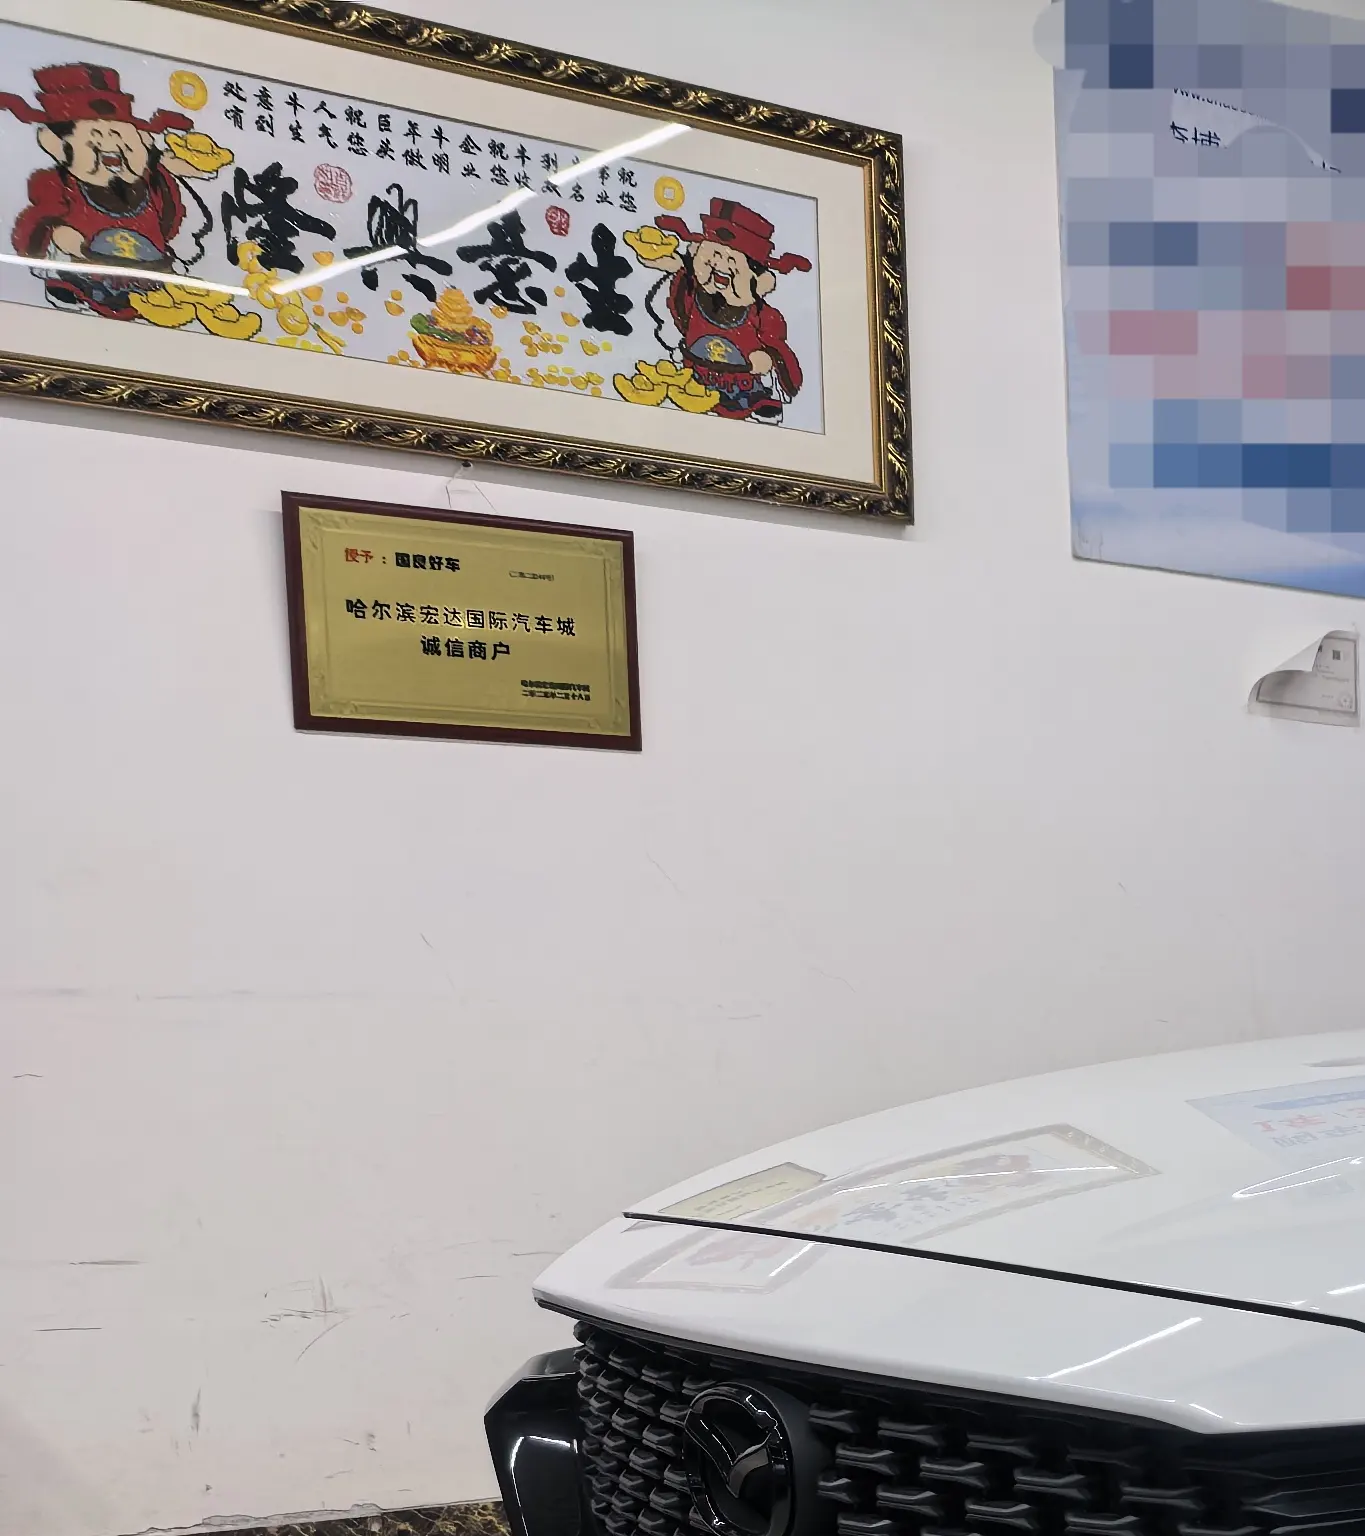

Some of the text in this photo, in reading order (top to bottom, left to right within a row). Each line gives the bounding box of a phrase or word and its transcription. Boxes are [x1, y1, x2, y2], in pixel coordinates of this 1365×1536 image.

[345, 598, 576, 637] 哈尔滨宏达国际汽车城
[420, 635, 511, 662] 诚信商户
